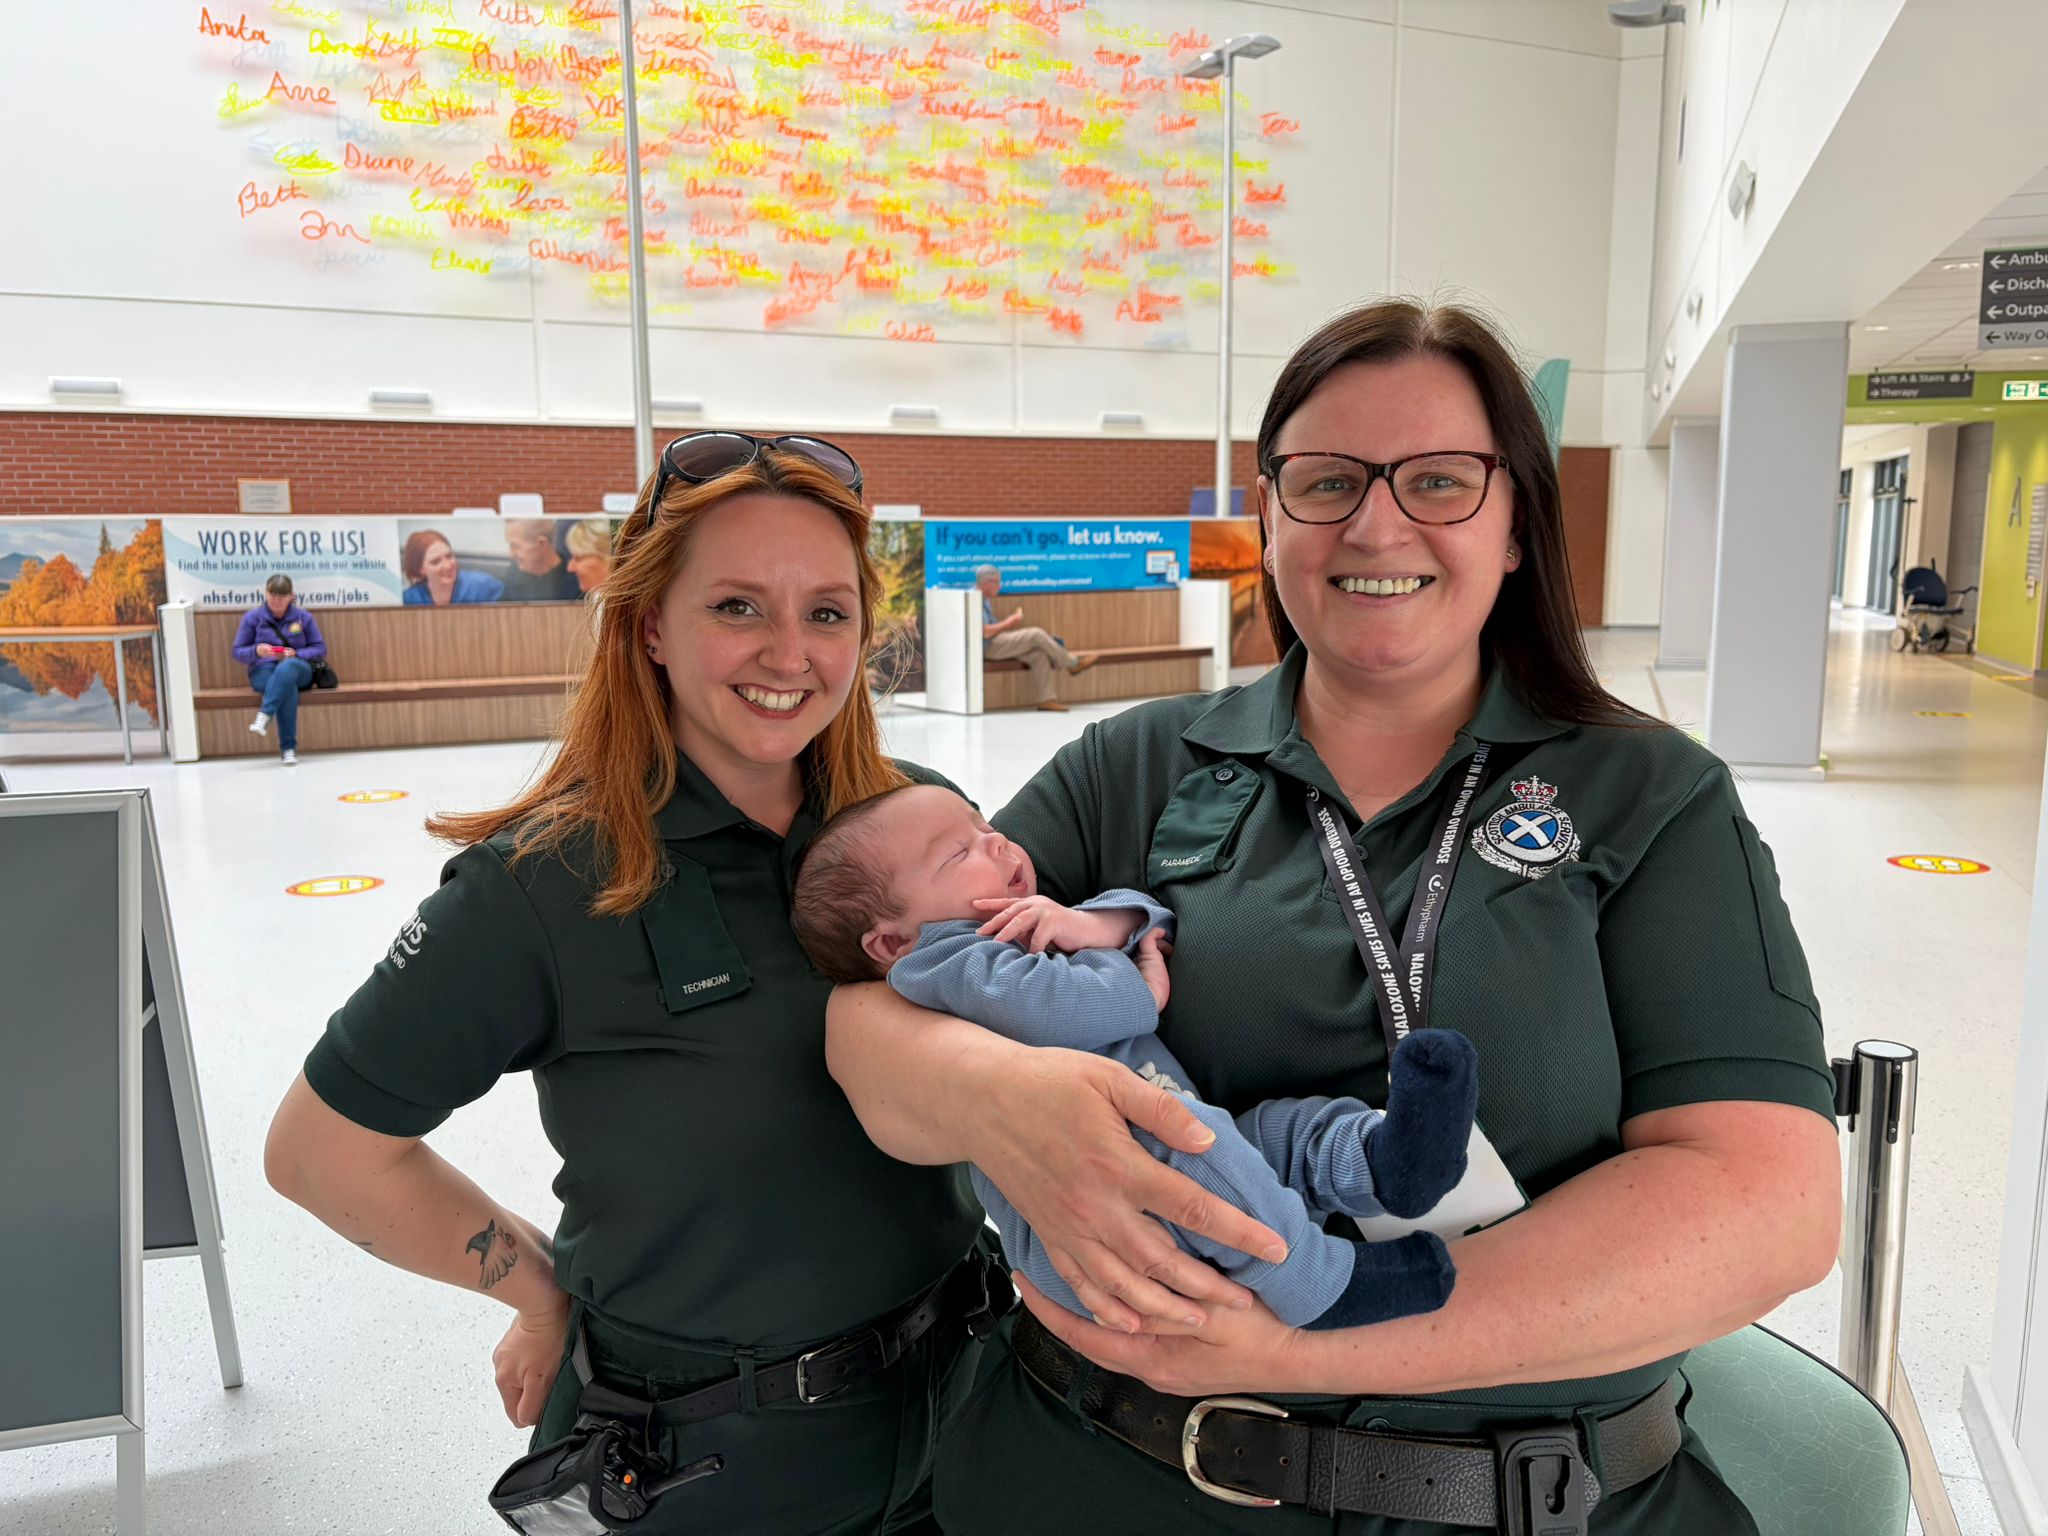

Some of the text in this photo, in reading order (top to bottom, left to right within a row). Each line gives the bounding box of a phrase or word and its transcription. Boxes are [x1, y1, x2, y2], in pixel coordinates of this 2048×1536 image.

[197, 6, 271, 45] Anita
[344, 142, 414, 174] Diane
[2004, 330, 2032, 343] Way
[198, 530, 366, 555] WORK FOR US!
[952, 532, 987, 550] you
[1067, 525, 1090, 545] let
[1092, 531, 1111, 545] us
[1114, 525, 1164, 545] know.
[178, 559, 199, 571] Find
[202, 559, 218, 571] the
[221, 559, 249, 571] latest
[252, 560, 267, 573] job
[271, 559, 316, 571] vacancies
[352, 559, 386, 569] website
[1463, 775, 1478, 788] AN
[1468, 764, 1483, 774] IN
[1451, 789, 1473, 817] OPIOID
[1436, 817, 1461, 865] OVERDOSE
[1488, 813, 1506, 845] SCOTTISH
[1551, 816, 1571, 853] SERVICE
[1318, 807, 1411, 1041] NALOXONE SAVES LIVES IN AN OPIOID OVERDOSE
[1416, 892, 1438, 943] Ethypharm
[682, 973, 730, 995] TECHNICIAN
